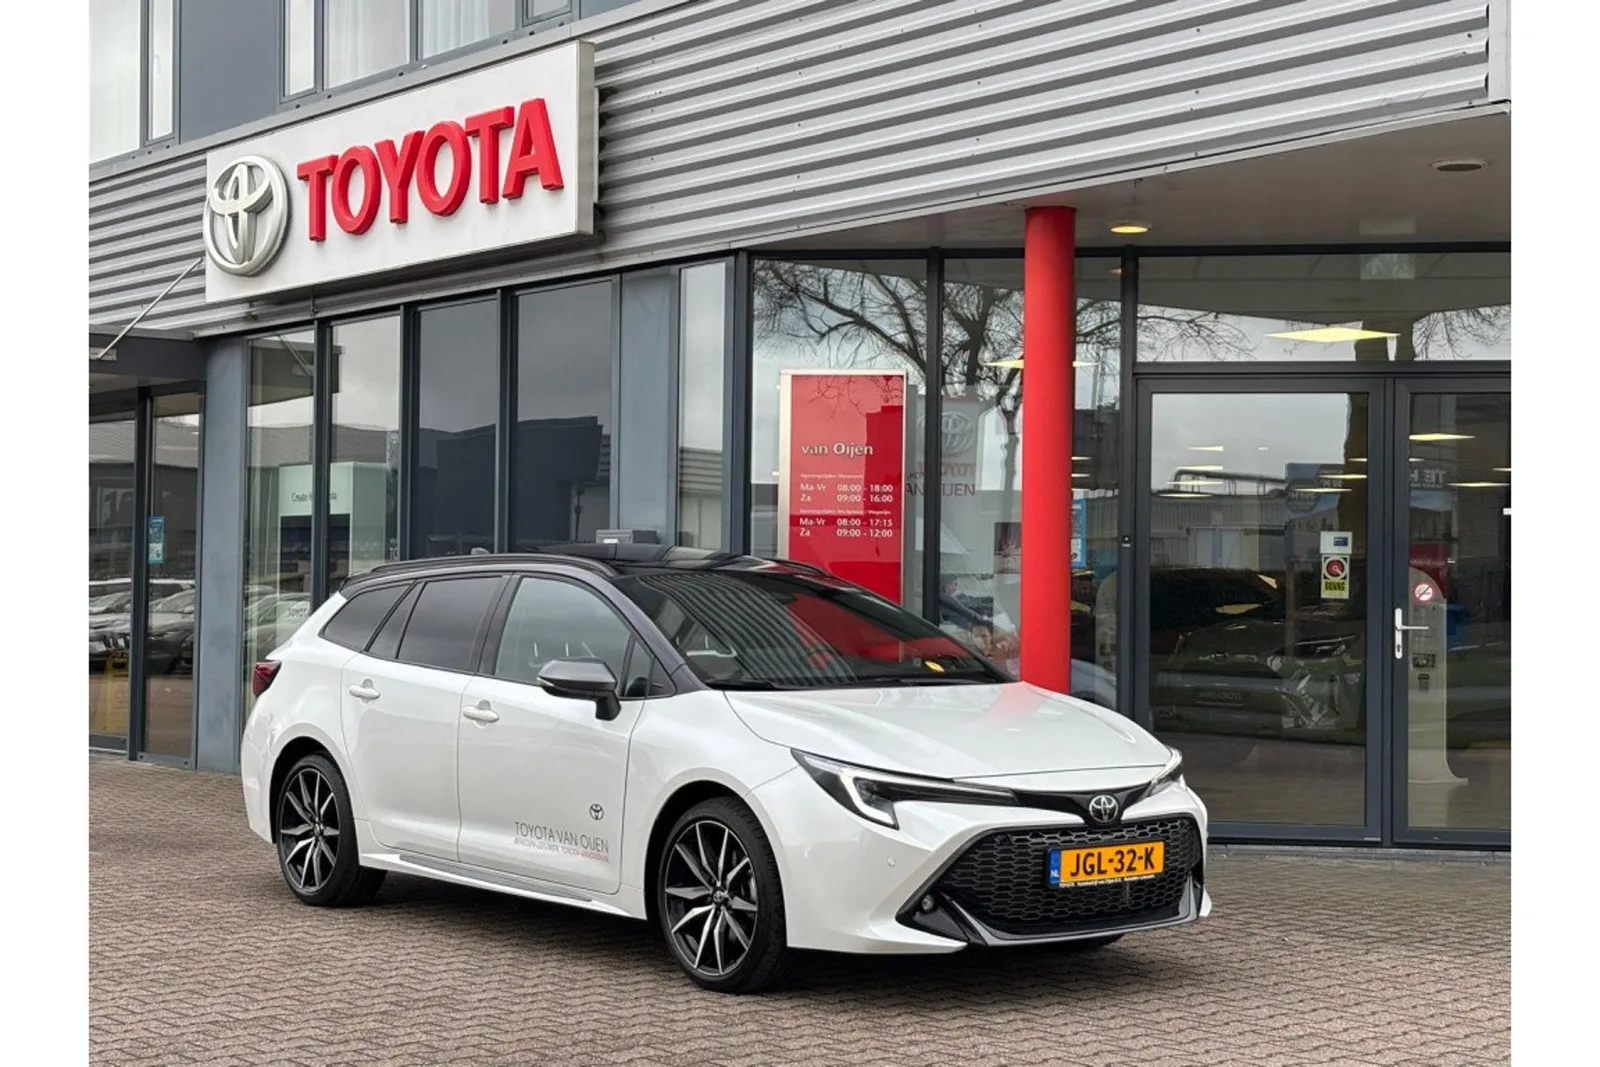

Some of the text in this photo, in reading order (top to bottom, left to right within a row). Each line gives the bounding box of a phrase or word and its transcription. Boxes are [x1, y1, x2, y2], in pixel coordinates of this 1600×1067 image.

[297, 97, 564, 242] TOYOTA
[801, 442, 874, 458] van Oijen
[836, 484, 861, 492] 08:00
[869, 484, 894, 492] 18:00
[836, 494, 861, 502] 09:00
[869, 494, 894, 503] 16:00
[799, 518, 826, 526] Ma-Vr
[836, 518, 861, 526] 08:00
[869, 519, 893, 527] 17:15
[799, 528, 811, 536] Za
[836, 528, 861, 537] 09:00
[869, 529, 893, 537] 12:00
[514, 821, 555, 843] TOYOTA
[556, 830, 578, 846] VAN
[1070, 847, 1155, 877] JGL-32-K
